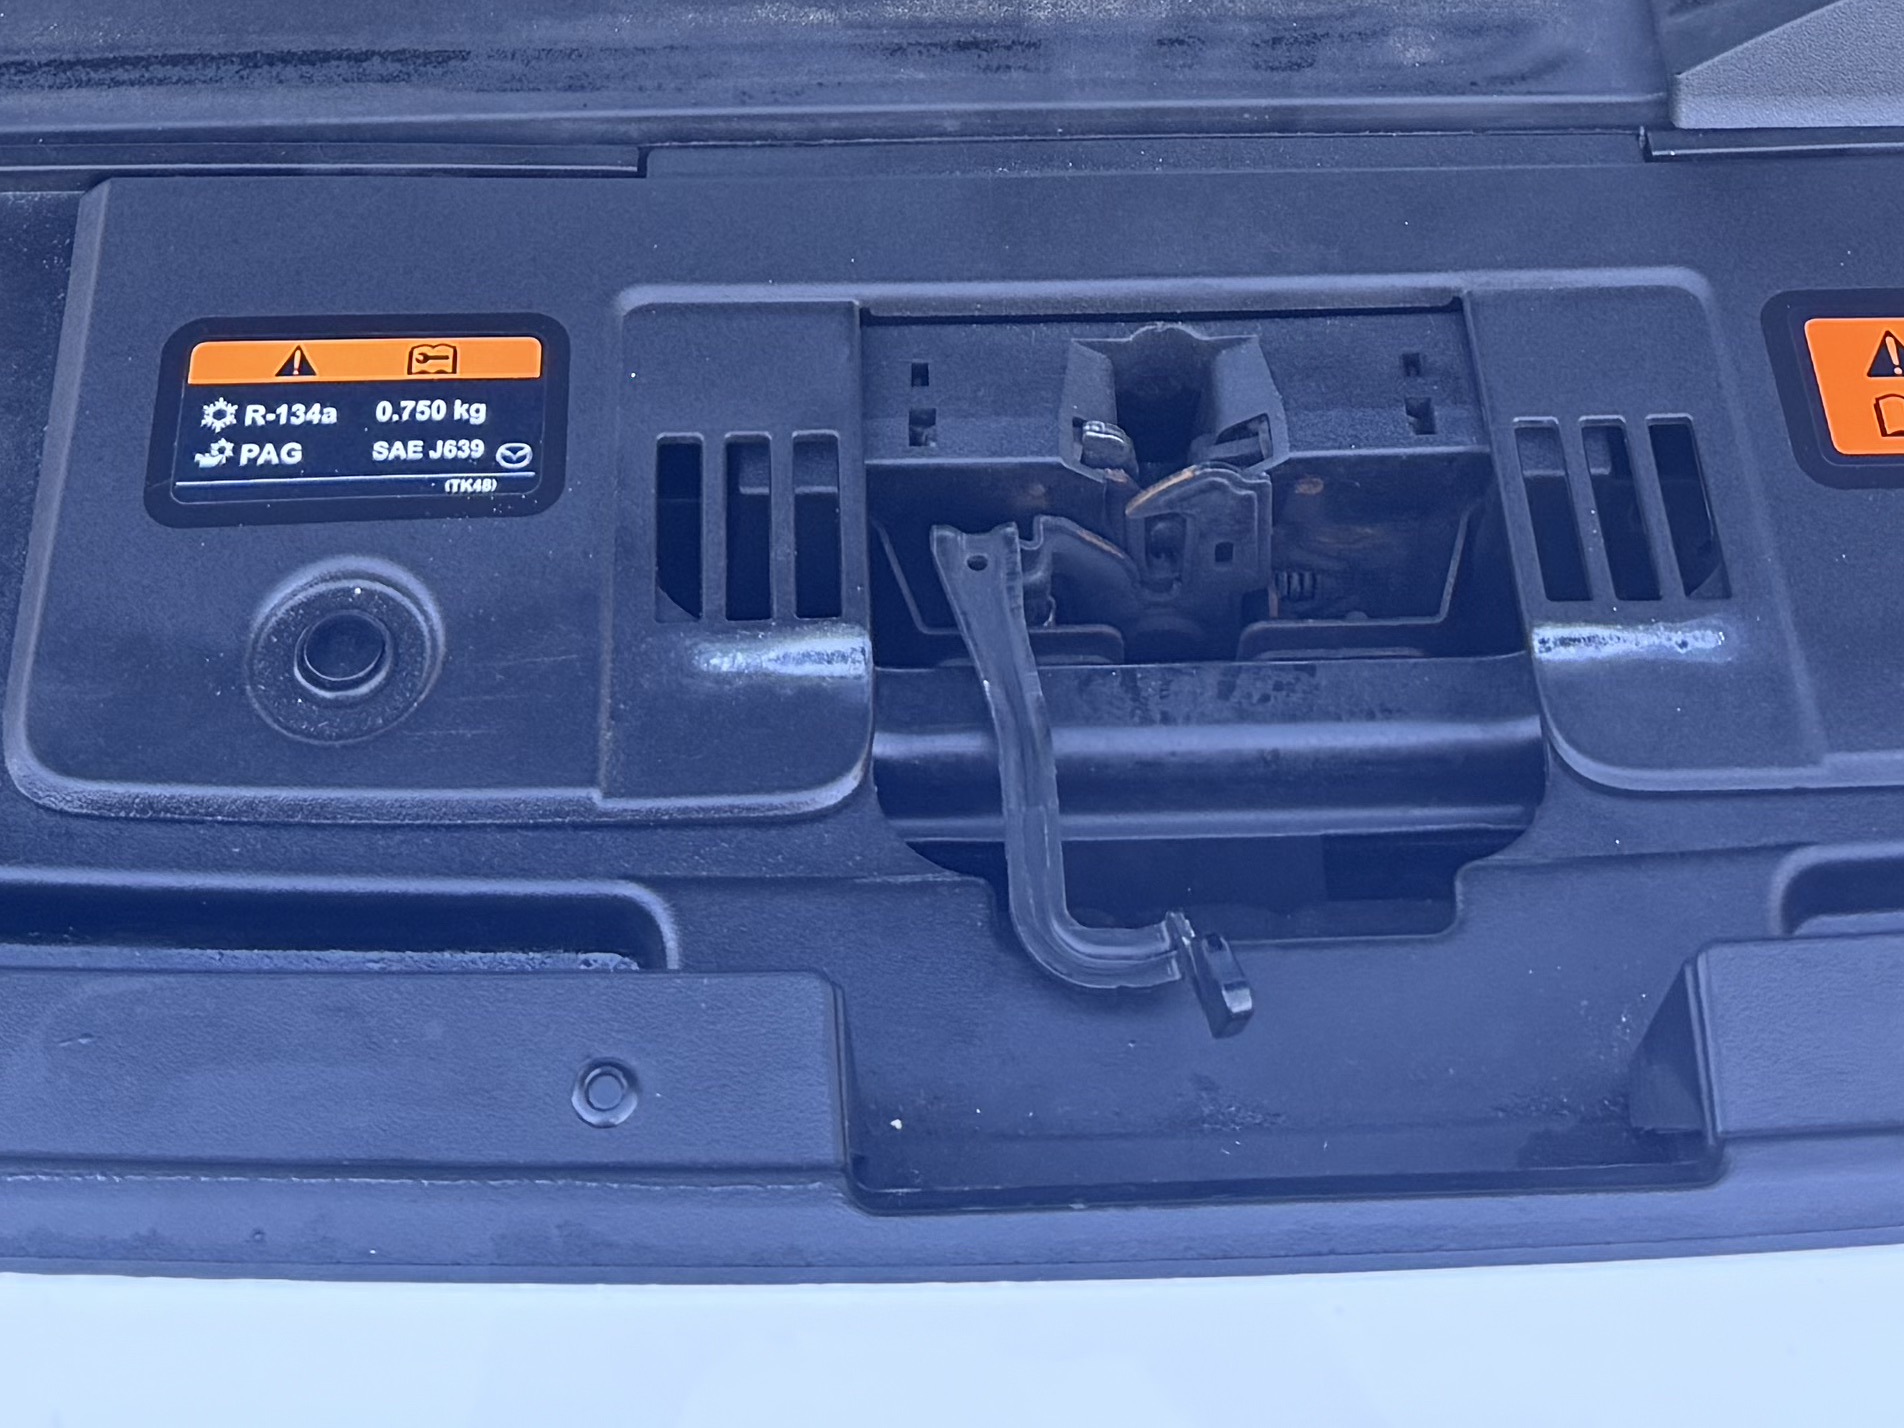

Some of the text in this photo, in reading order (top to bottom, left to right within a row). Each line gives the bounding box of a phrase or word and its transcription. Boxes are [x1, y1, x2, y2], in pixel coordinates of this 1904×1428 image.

[245, 399, 487, 426] R-134a 0.750 kg
[239, 439, 485, 466] PAG SAE J639
